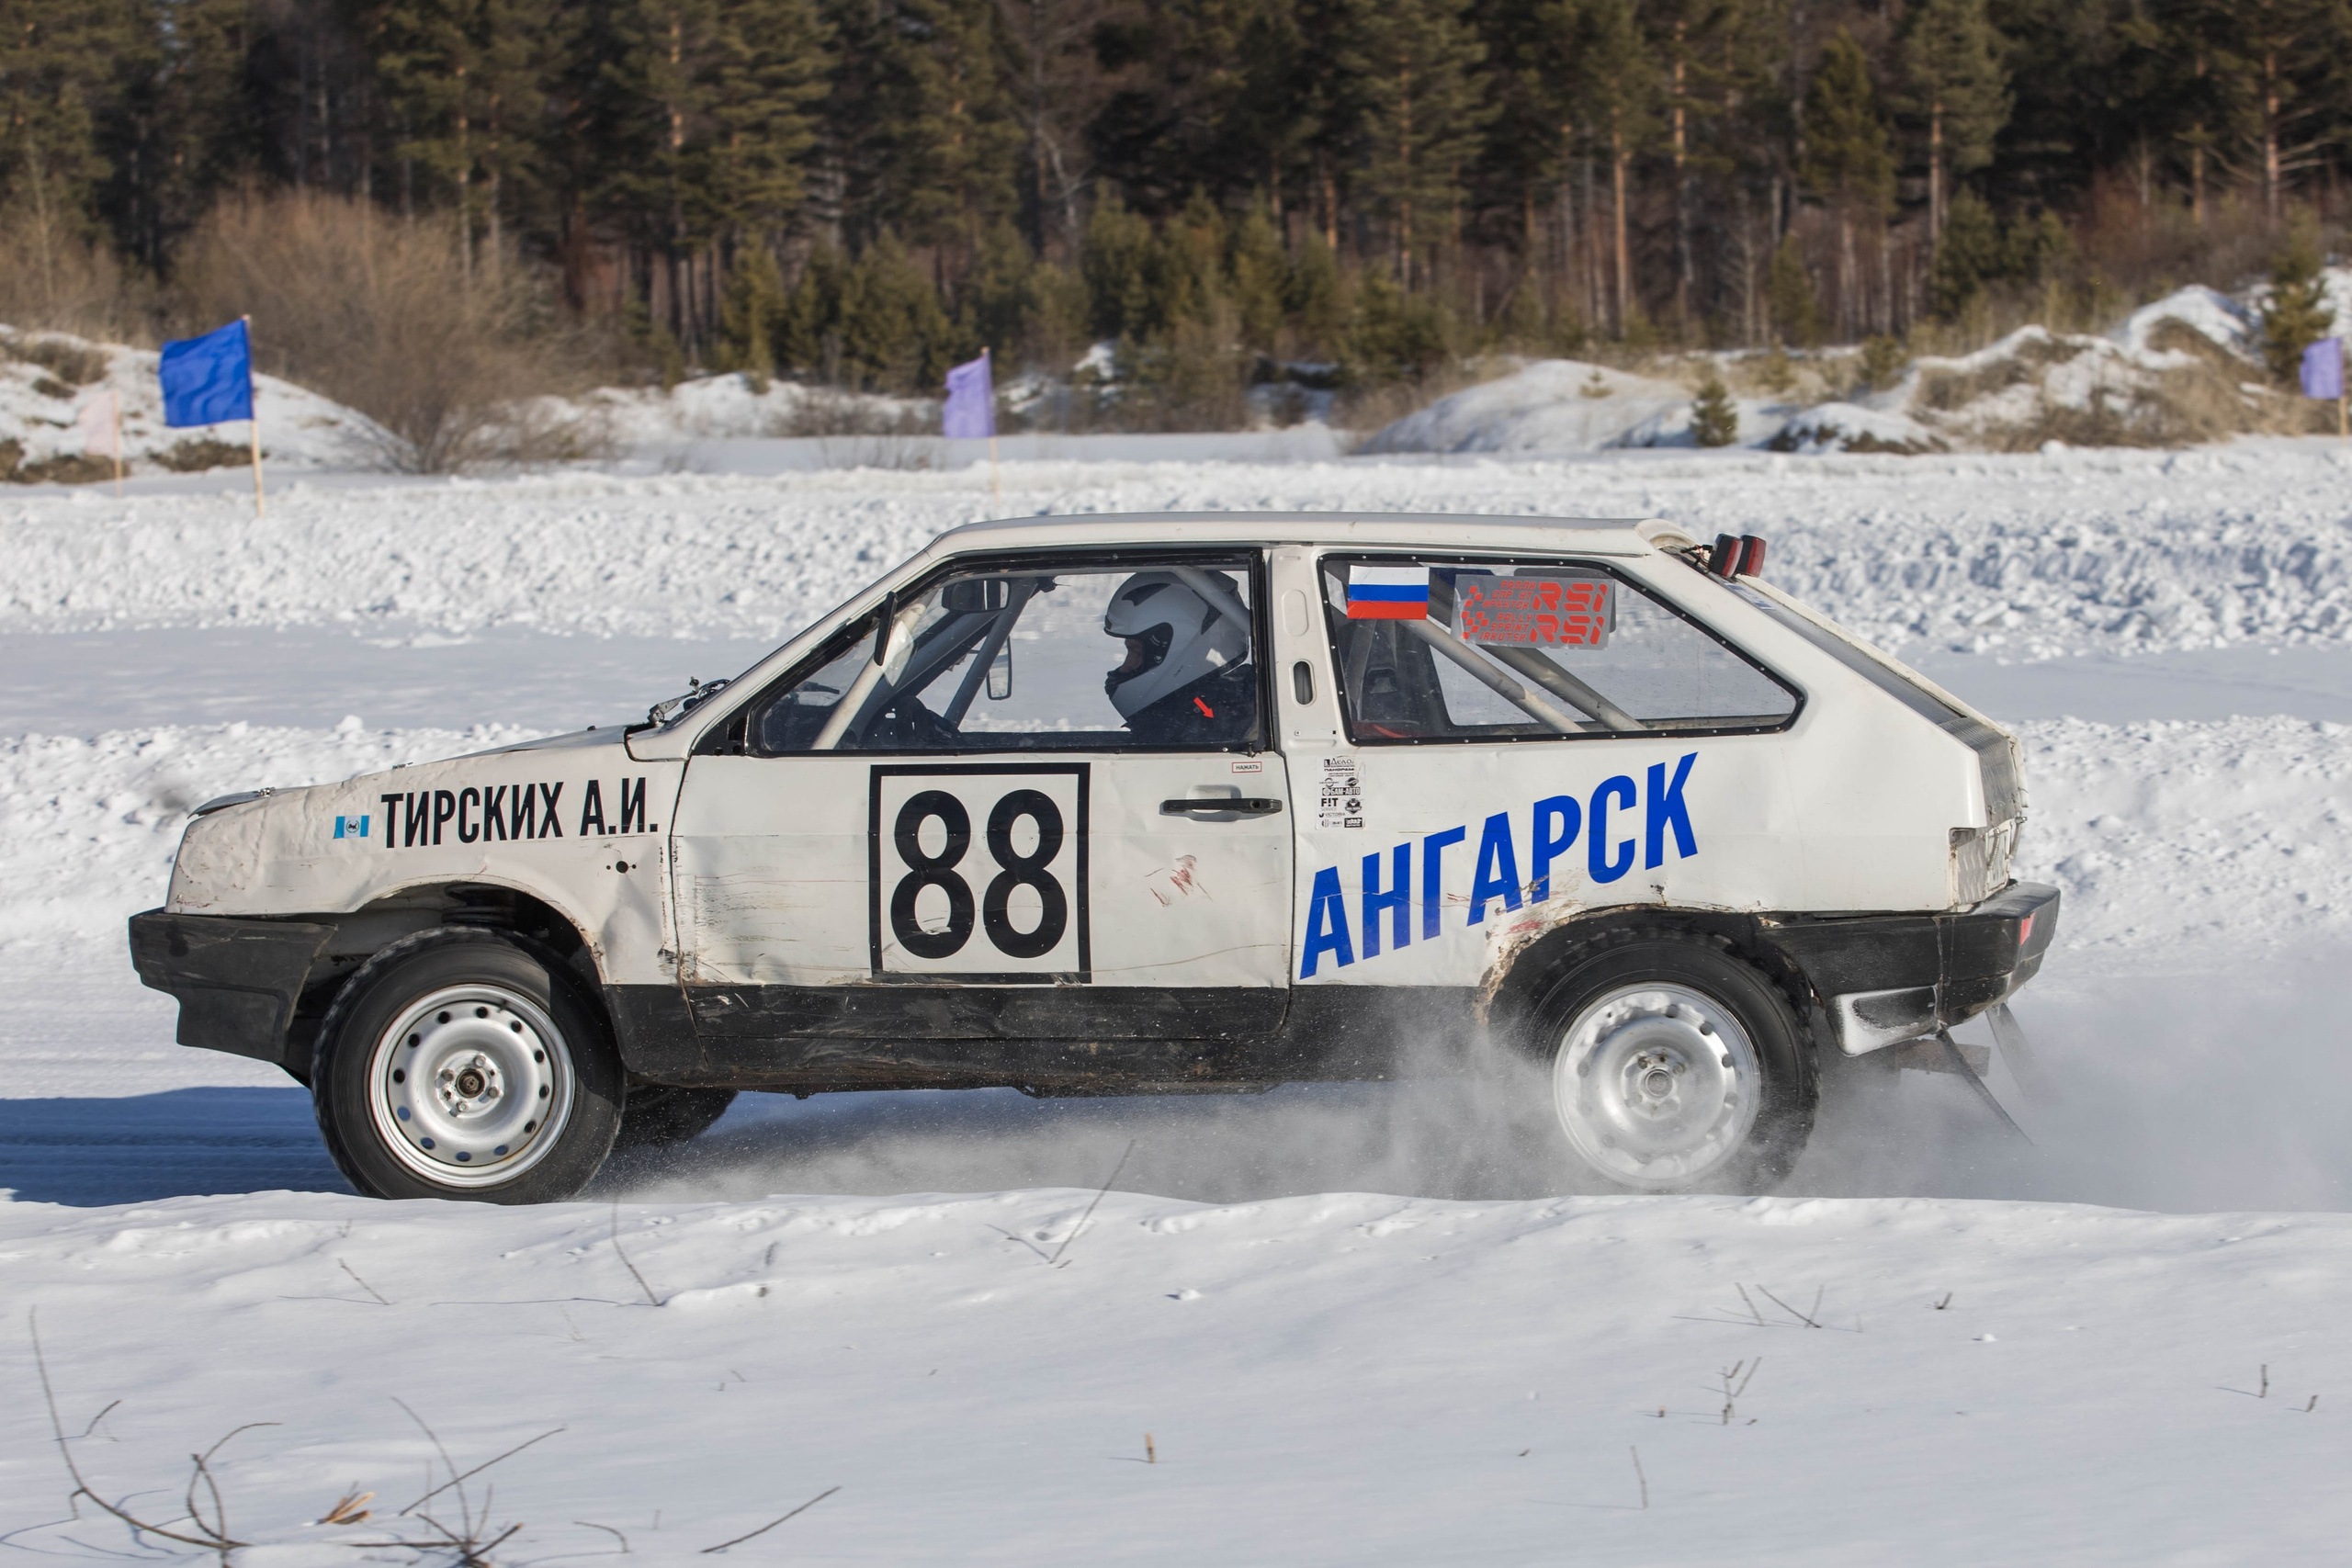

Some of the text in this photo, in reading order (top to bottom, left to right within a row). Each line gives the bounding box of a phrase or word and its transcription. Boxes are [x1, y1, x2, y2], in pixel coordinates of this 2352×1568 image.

[1479, 631, 1527, 642] IRKUTSK
[1489, 622, 1530, 632] SPRINT
[1497, 612, 1533, 622] RALLY
[381, 777, 659, 848] ТИРСКИХ А.И.
[890, 789, 1068, 959] 88
[1299, 751, 1699, 980] АНГАРСК
